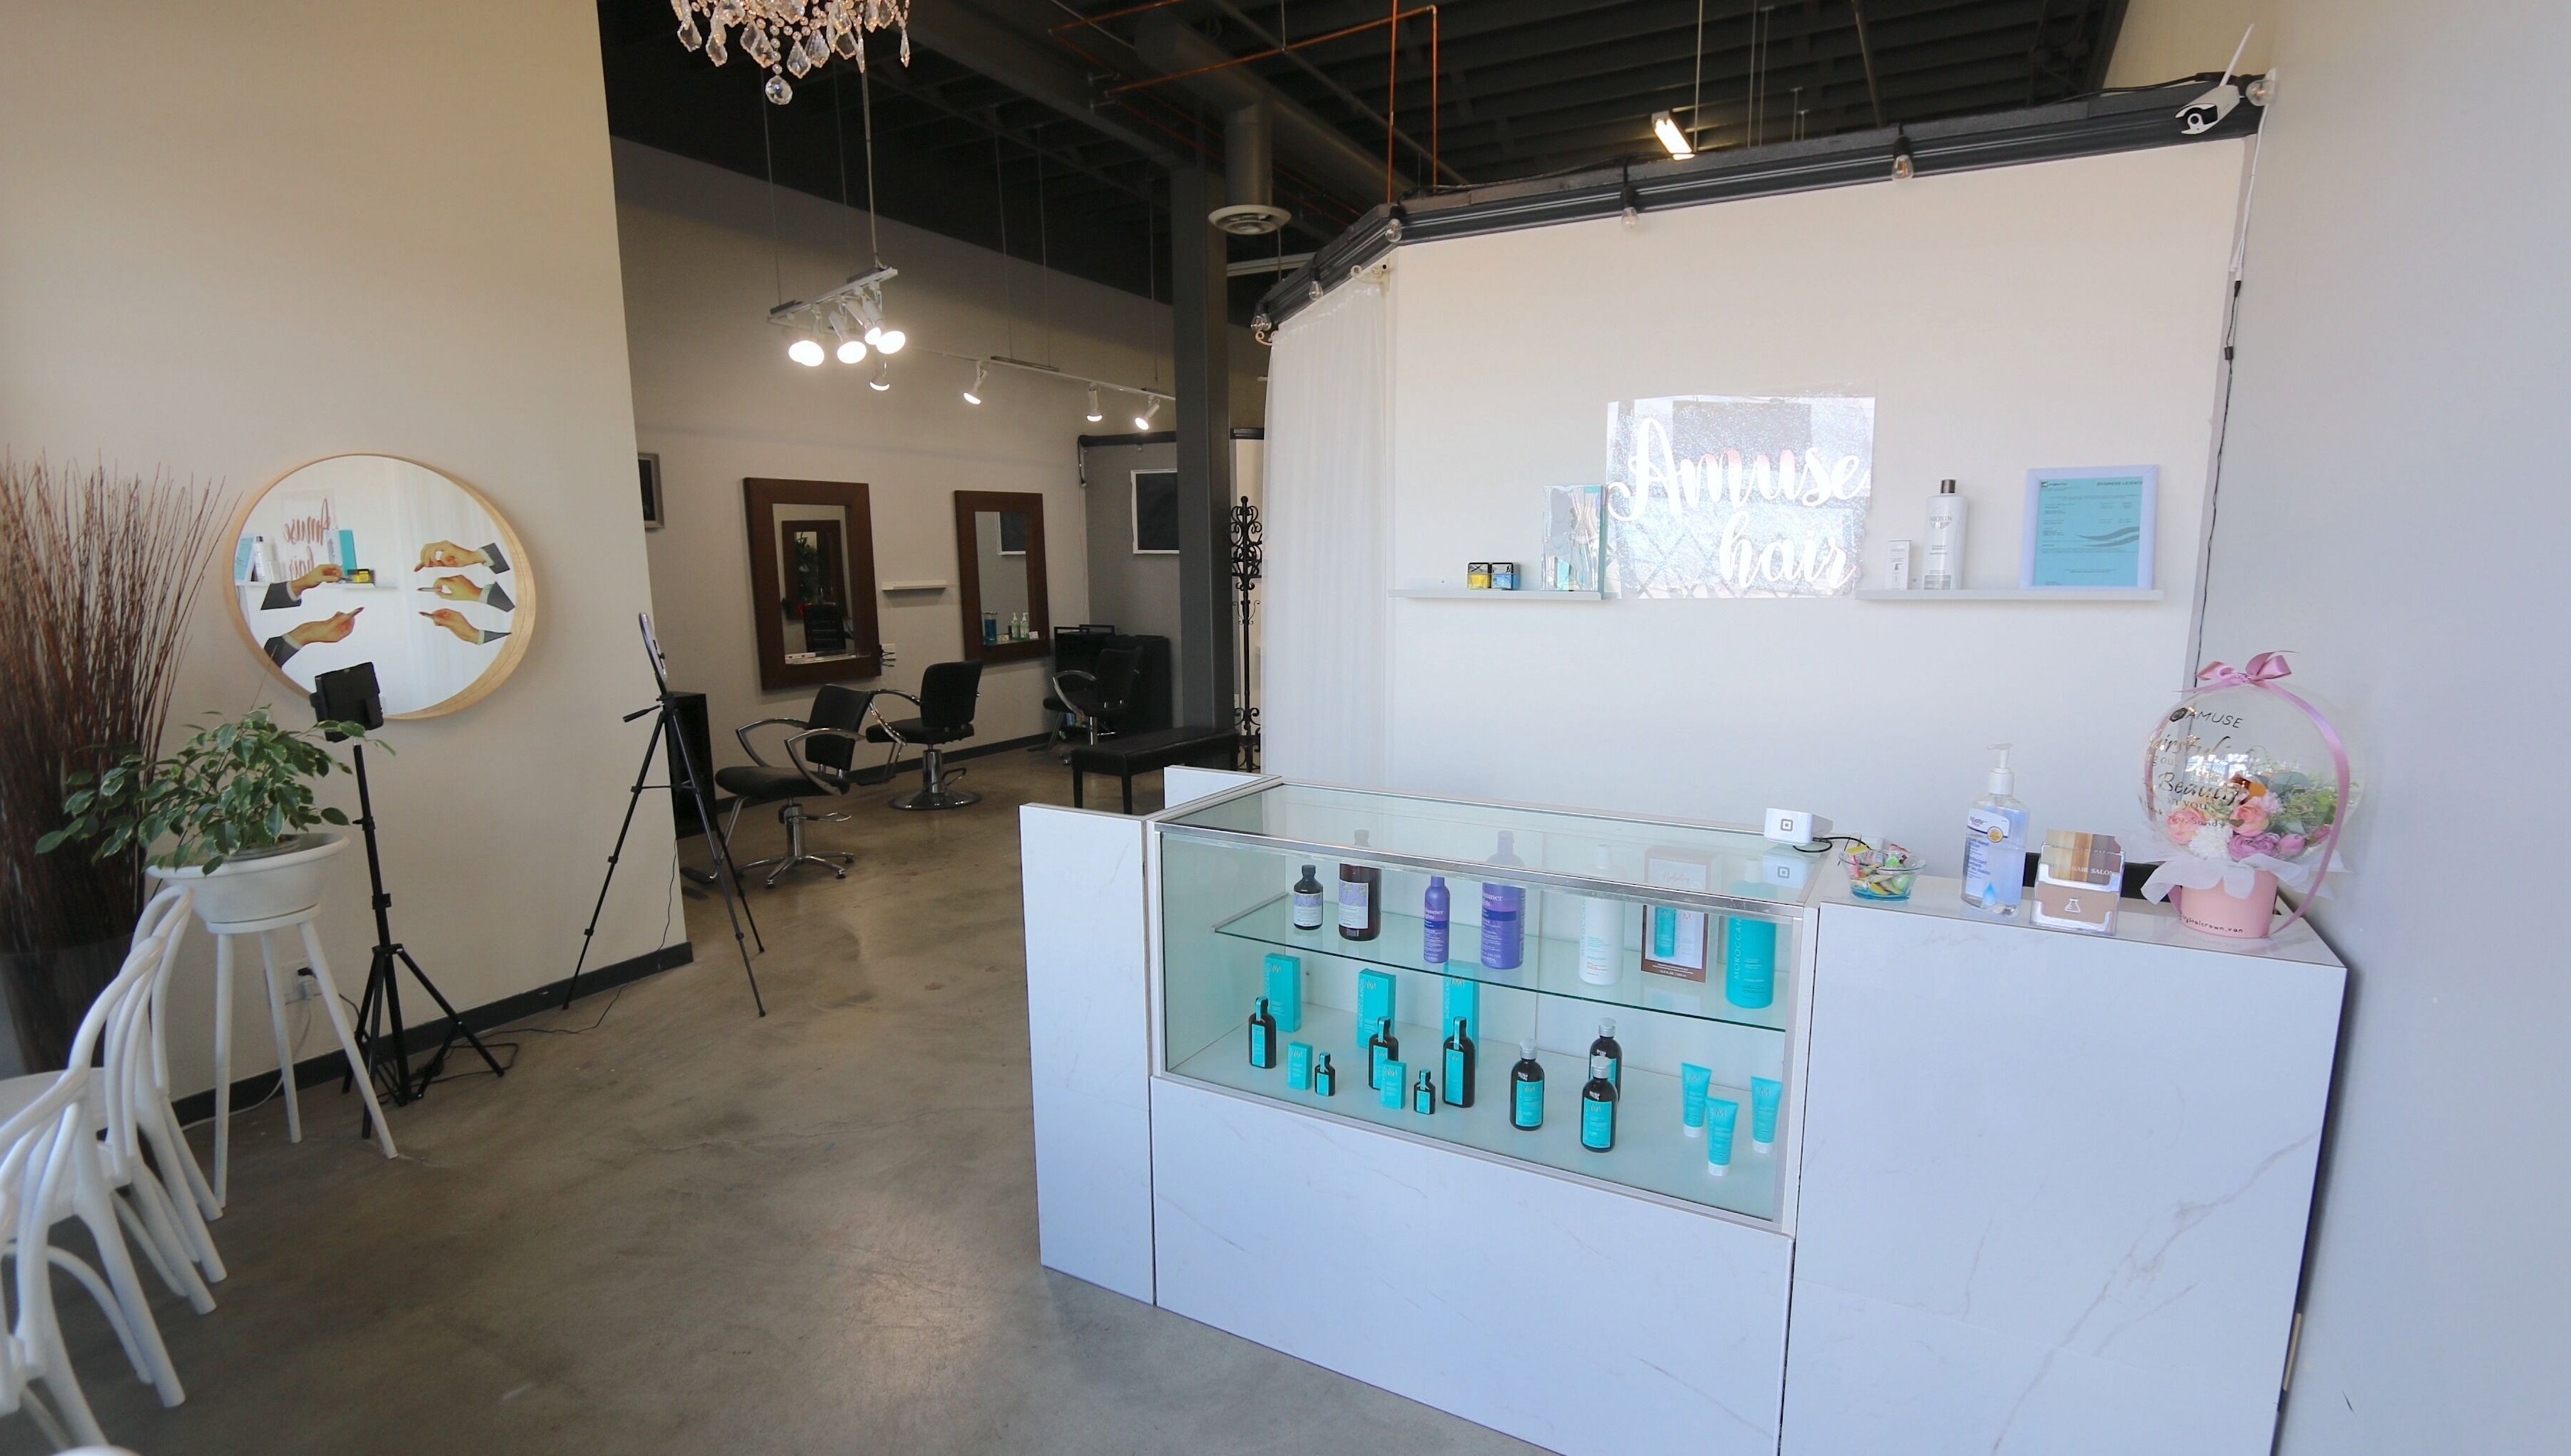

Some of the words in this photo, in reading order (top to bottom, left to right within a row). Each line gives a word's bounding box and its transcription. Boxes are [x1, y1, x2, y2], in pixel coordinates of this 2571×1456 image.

[1607, 417, 1870, 522] Amuse
[1719, 509, 1857, 589] hair
[2187, 711, 2246, 729] AMUSE
